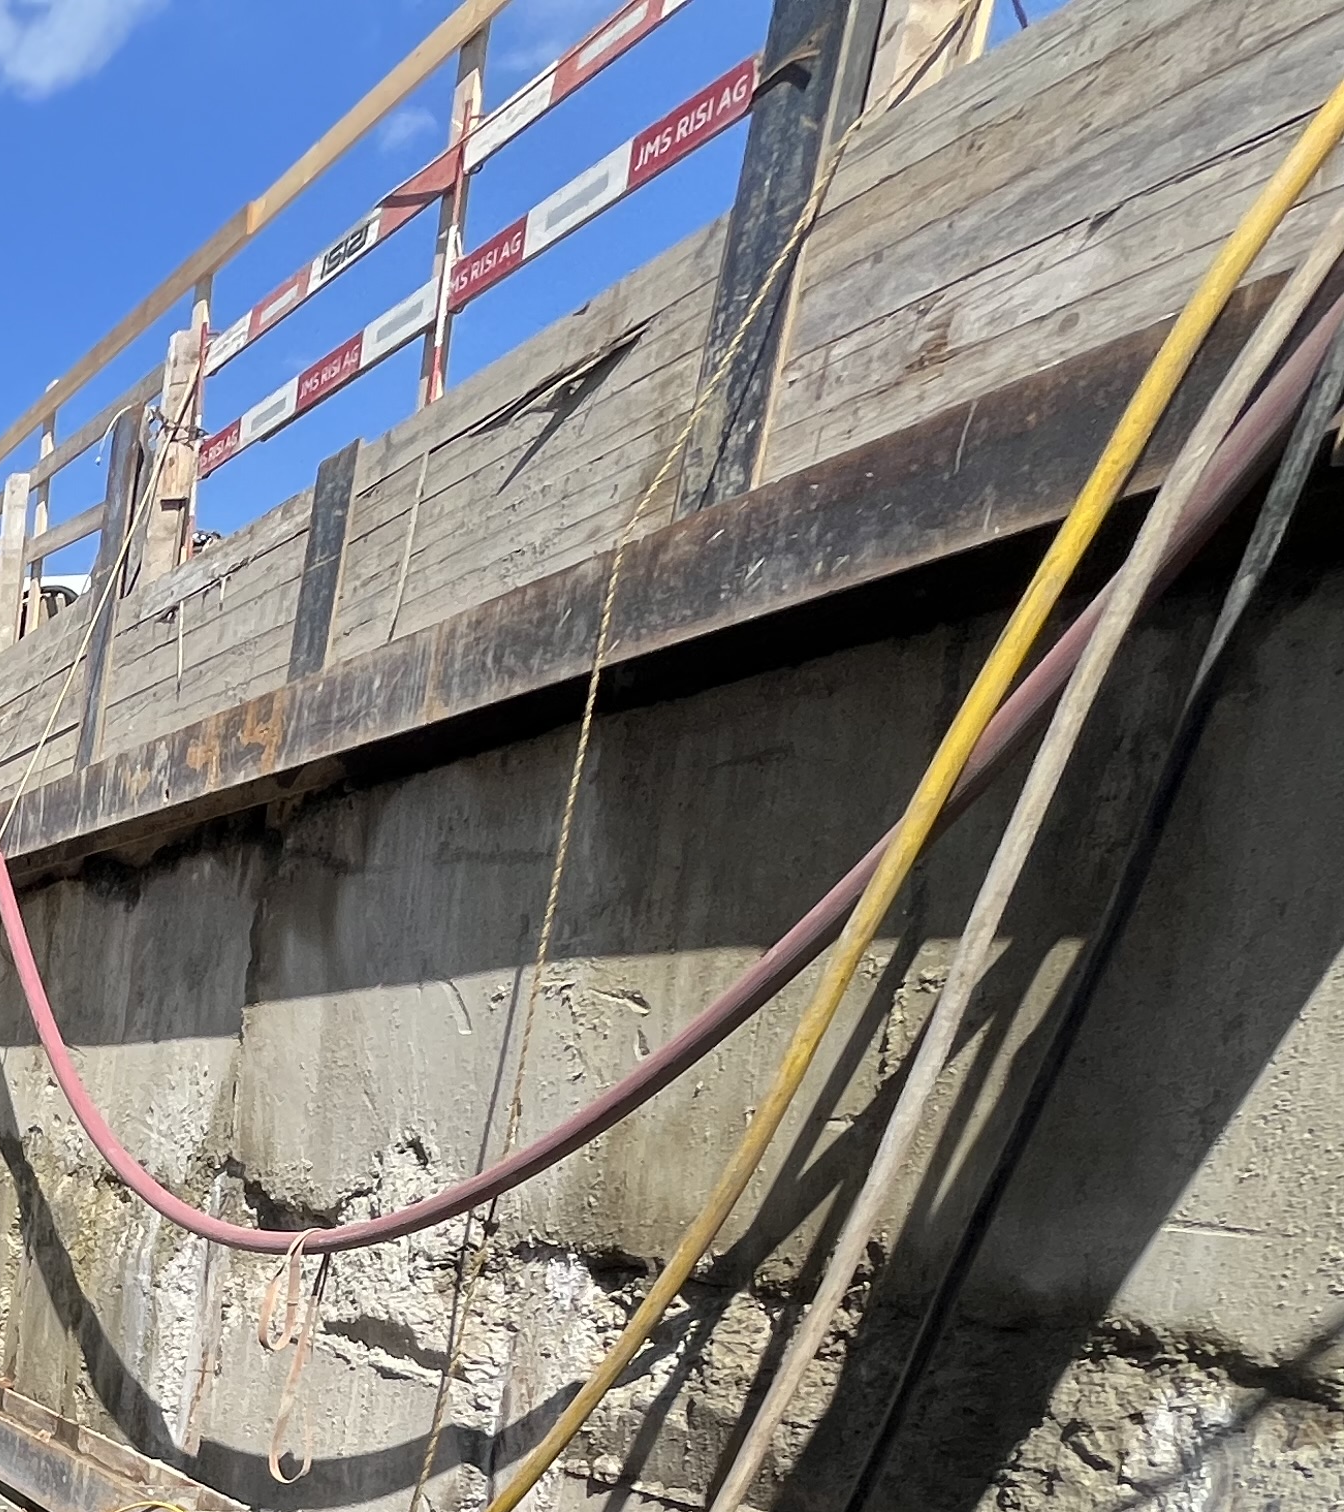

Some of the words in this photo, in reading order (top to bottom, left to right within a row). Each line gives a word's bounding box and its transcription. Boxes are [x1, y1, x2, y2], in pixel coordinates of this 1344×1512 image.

[634, 126, 672, 171] JMS
[675, 97, 714, 144] RISI
[716, 74, 748, 117] AG
[470, 247, 499, 282] RISI
[499, 231, 522, 263] AG
